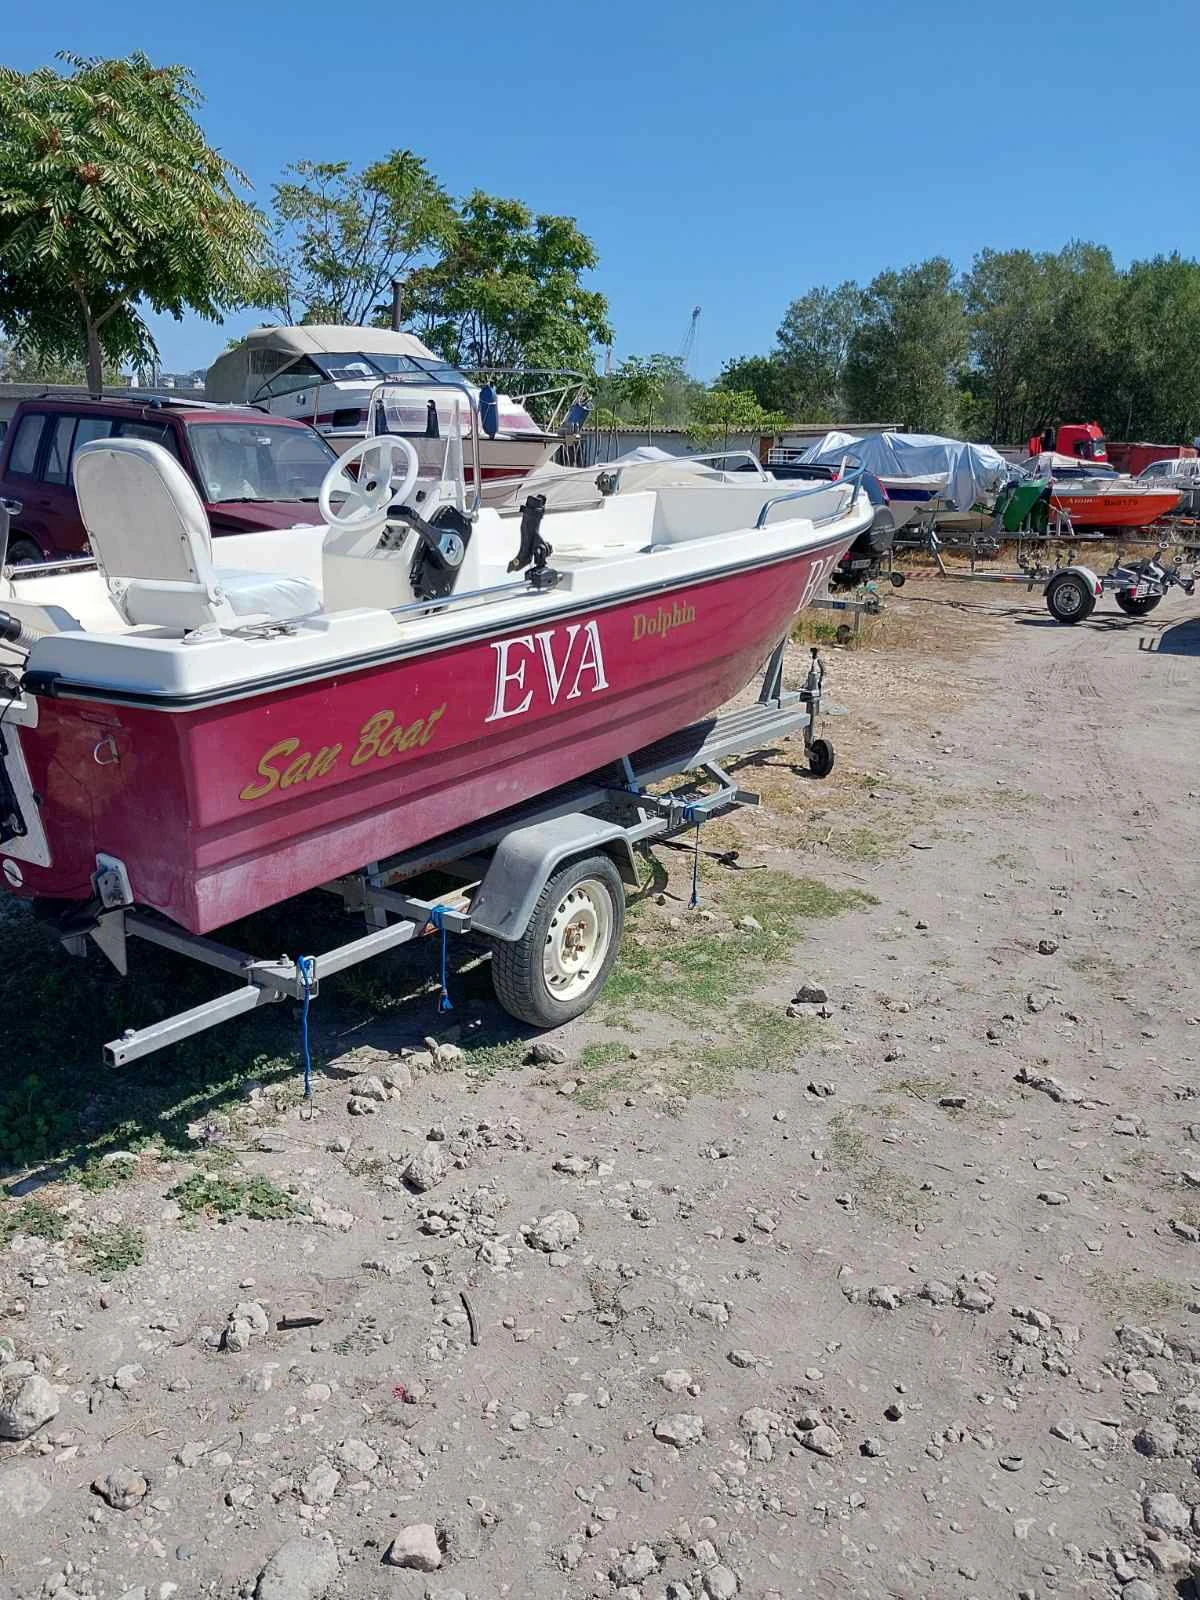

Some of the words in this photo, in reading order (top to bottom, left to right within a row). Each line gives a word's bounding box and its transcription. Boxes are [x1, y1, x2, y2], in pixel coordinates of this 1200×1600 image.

[632, 600, 697, 641] Dolphin
[484, 619, 609, 723] EVA
[239, 737, 343, 800] San
[351, 702, 447, 766] Boat
